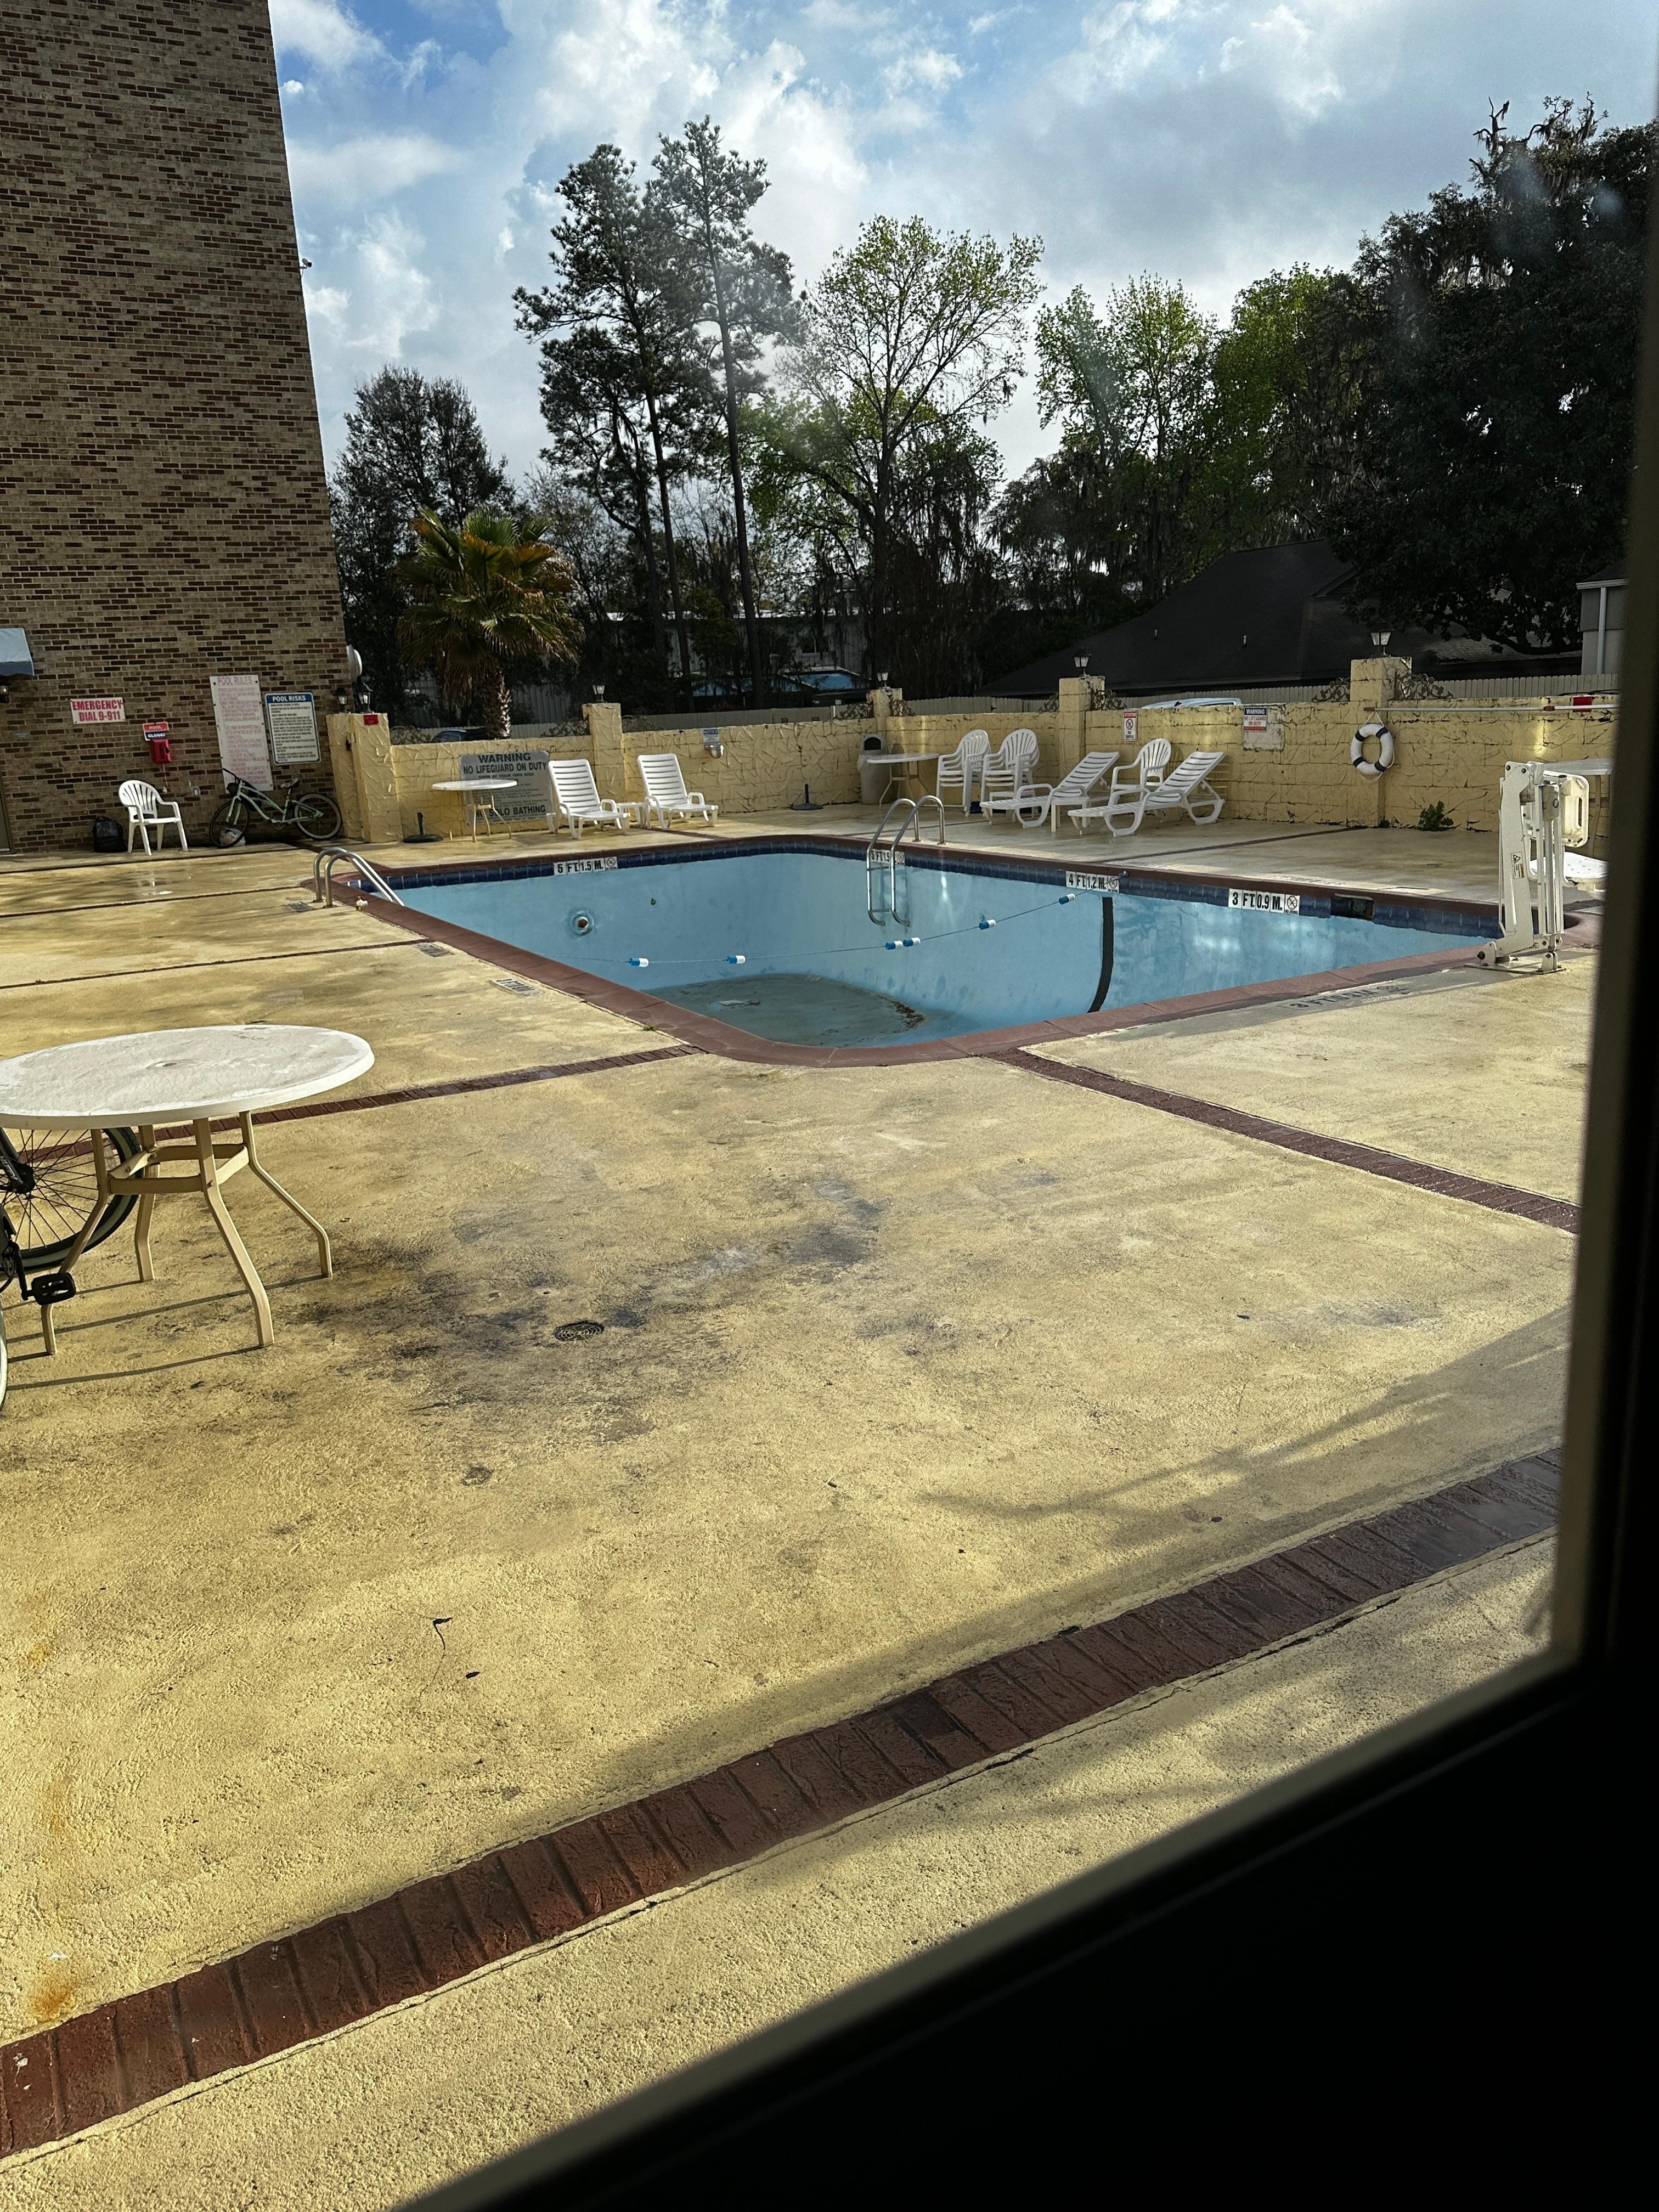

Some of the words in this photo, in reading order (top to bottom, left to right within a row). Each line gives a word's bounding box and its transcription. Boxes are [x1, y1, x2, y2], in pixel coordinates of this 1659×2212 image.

[217, 676, 233, 685] POOL
[234, 676, 252, 685] RULES
[72, 699, 122, 710] EMERGENCY
[79, 712, 97, 721] DIAL
[99, 710, 121, 721] 9-911
[478, 752, 531, 763] WARNING
[464, 766, 473, 775] NO
[476, 764, 514, 774] LIFEGUARD
[516, 763, 527, 771] ON
[529, 761, 546, 770] DUTY
[489, 808, 510, 817] SOLO
[513, 805, 546, 815] BATHING
[871, 850, 875, 860] 5
[557, 864, 563, 873] 5
[580, 861, 591, 871] 1.5
[594, 860, 603, 870] M.
[1069, 873, 1074, 885] 4
[1086, 876, 1097, 888] 1.2
[1232, 891, 1238, 905] 3
[1243, 893, 1255, 907] FT.
[1257, 894, 1269, 909] 0.9
[1272, 896, 1283, 911] M.
